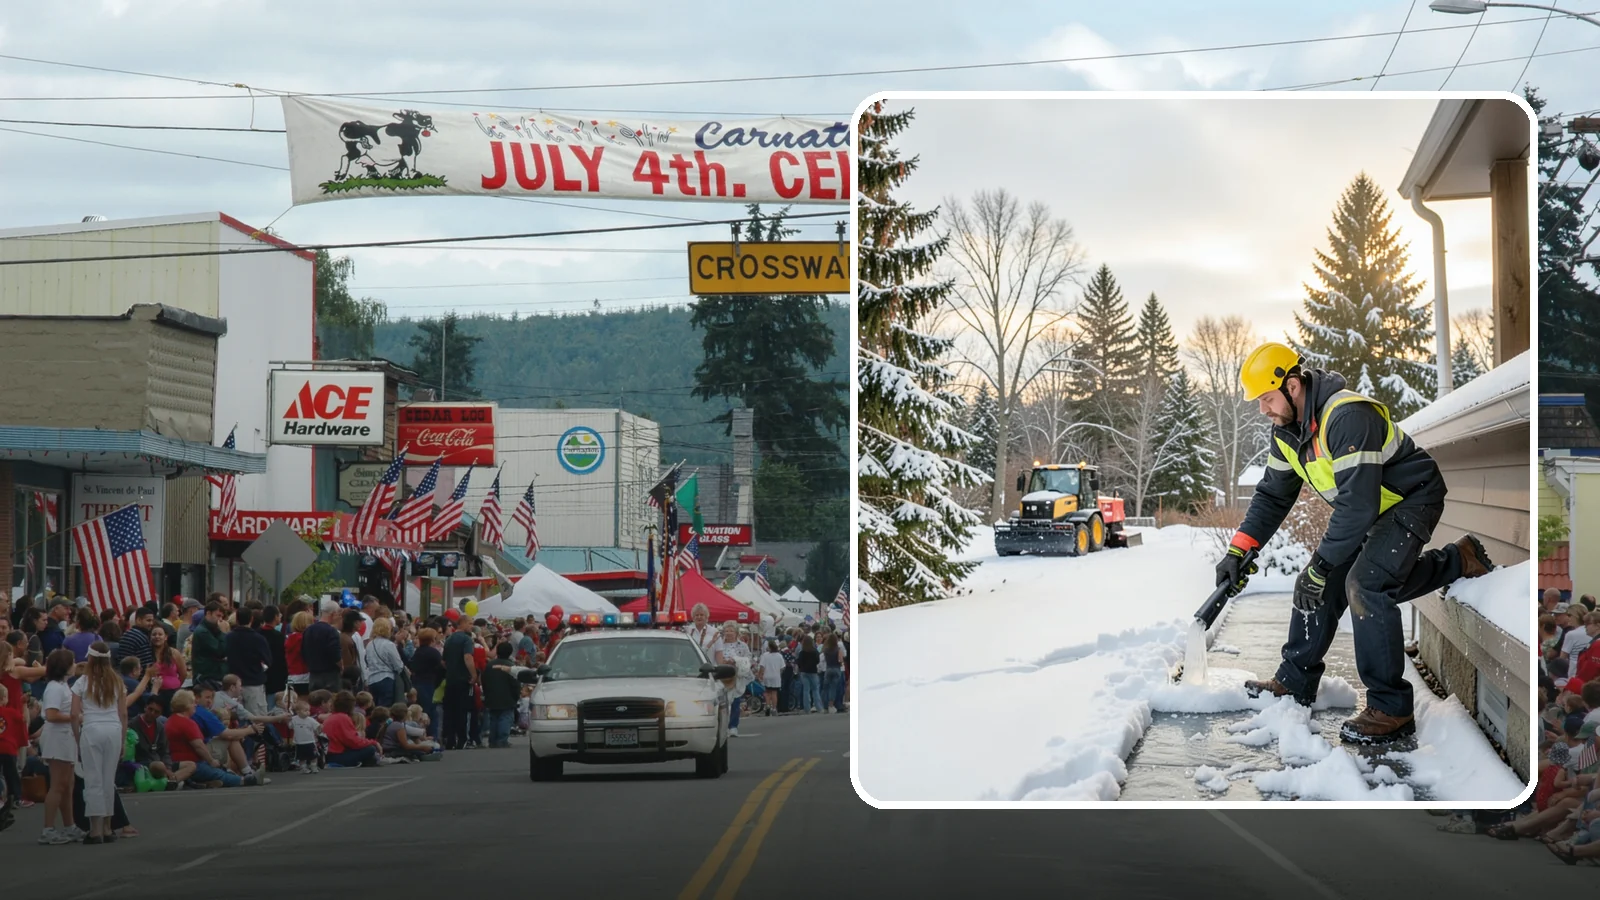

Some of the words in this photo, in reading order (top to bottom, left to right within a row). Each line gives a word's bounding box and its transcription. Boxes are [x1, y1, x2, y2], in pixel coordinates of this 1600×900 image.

[481, 141, 605, 192] JULY
[632, 150, 746, 198] 4th.
[697, 254, 850, 280] CROSSWA
[283, 380, 373, 420] ACE
[406, 409, 452, 421] CEDAR
[461, 409, 485, 421] LOG
[283, 421, 370, 436] Hardware
[416, 428, 477, 447] Coca-Cola
[353, 467, 386, 480] Simpl
[83, 486, 93, 494] St.
[96, 486, 123, 494] Vincent
[126, 486, 135, 494] de
[138, 486, 155, 495] Paul
[81, 503, 153, 521] THT
[213, 516, 331, 535] HARDARE
[688, 526, 741, 535] CRNATION
[699, 535, 730, 543] GLASS
